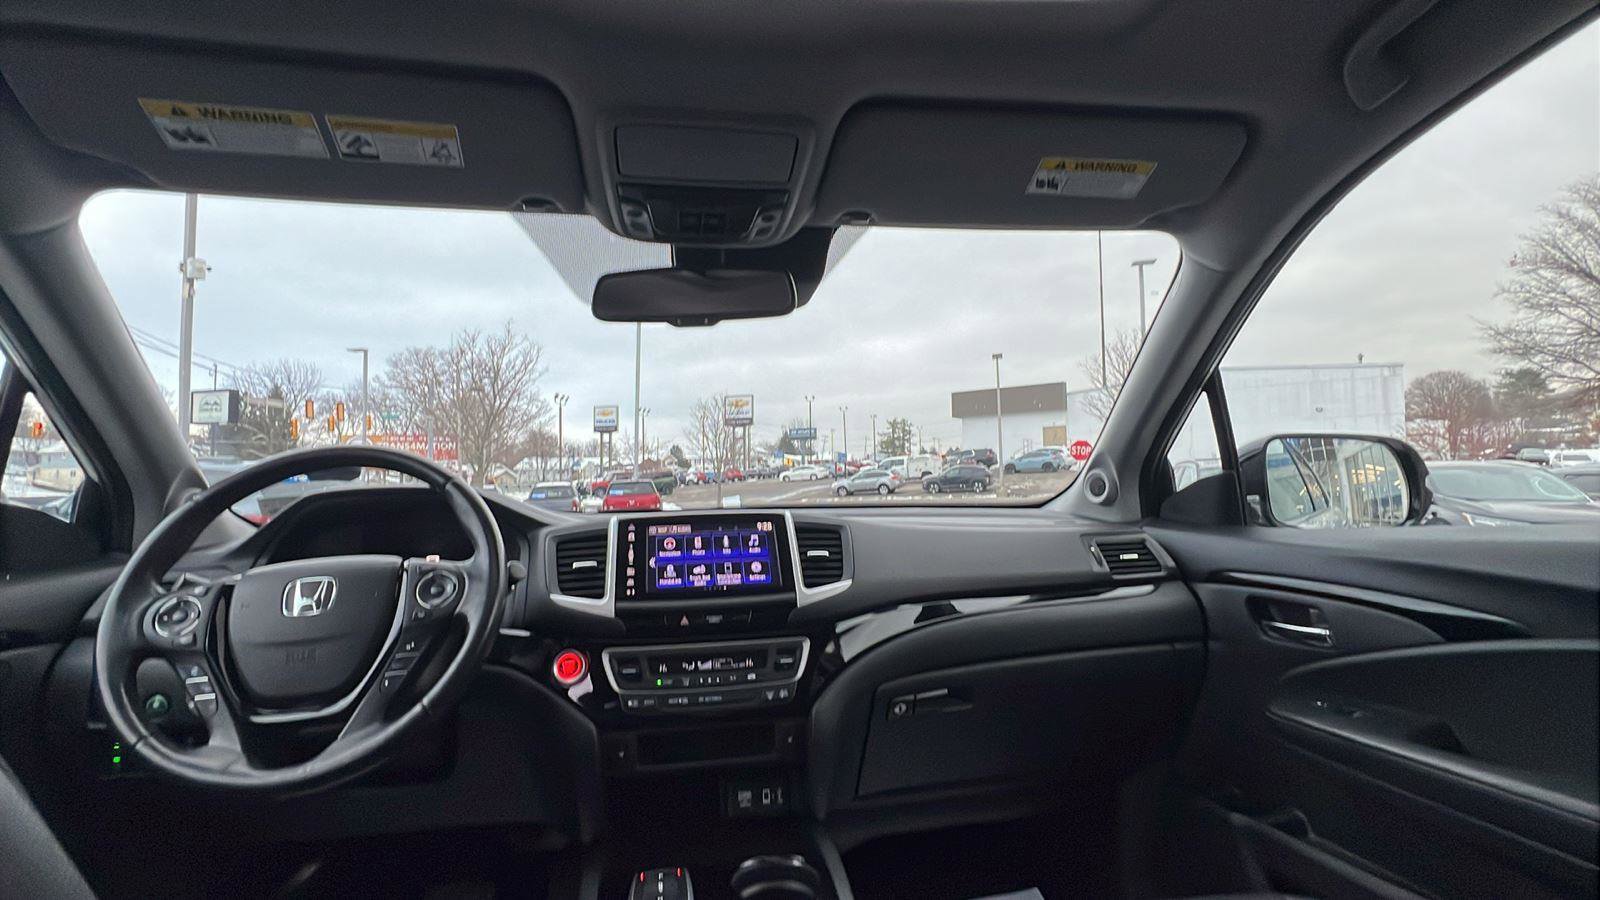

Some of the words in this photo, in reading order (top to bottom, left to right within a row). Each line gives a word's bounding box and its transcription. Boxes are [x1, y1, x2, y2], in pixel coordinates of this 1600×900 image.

[198, 106, 292, 124] WARNING
[1073, 160, 1138, 173] WARNING
[1071, 445, 1092, 456] STOP
